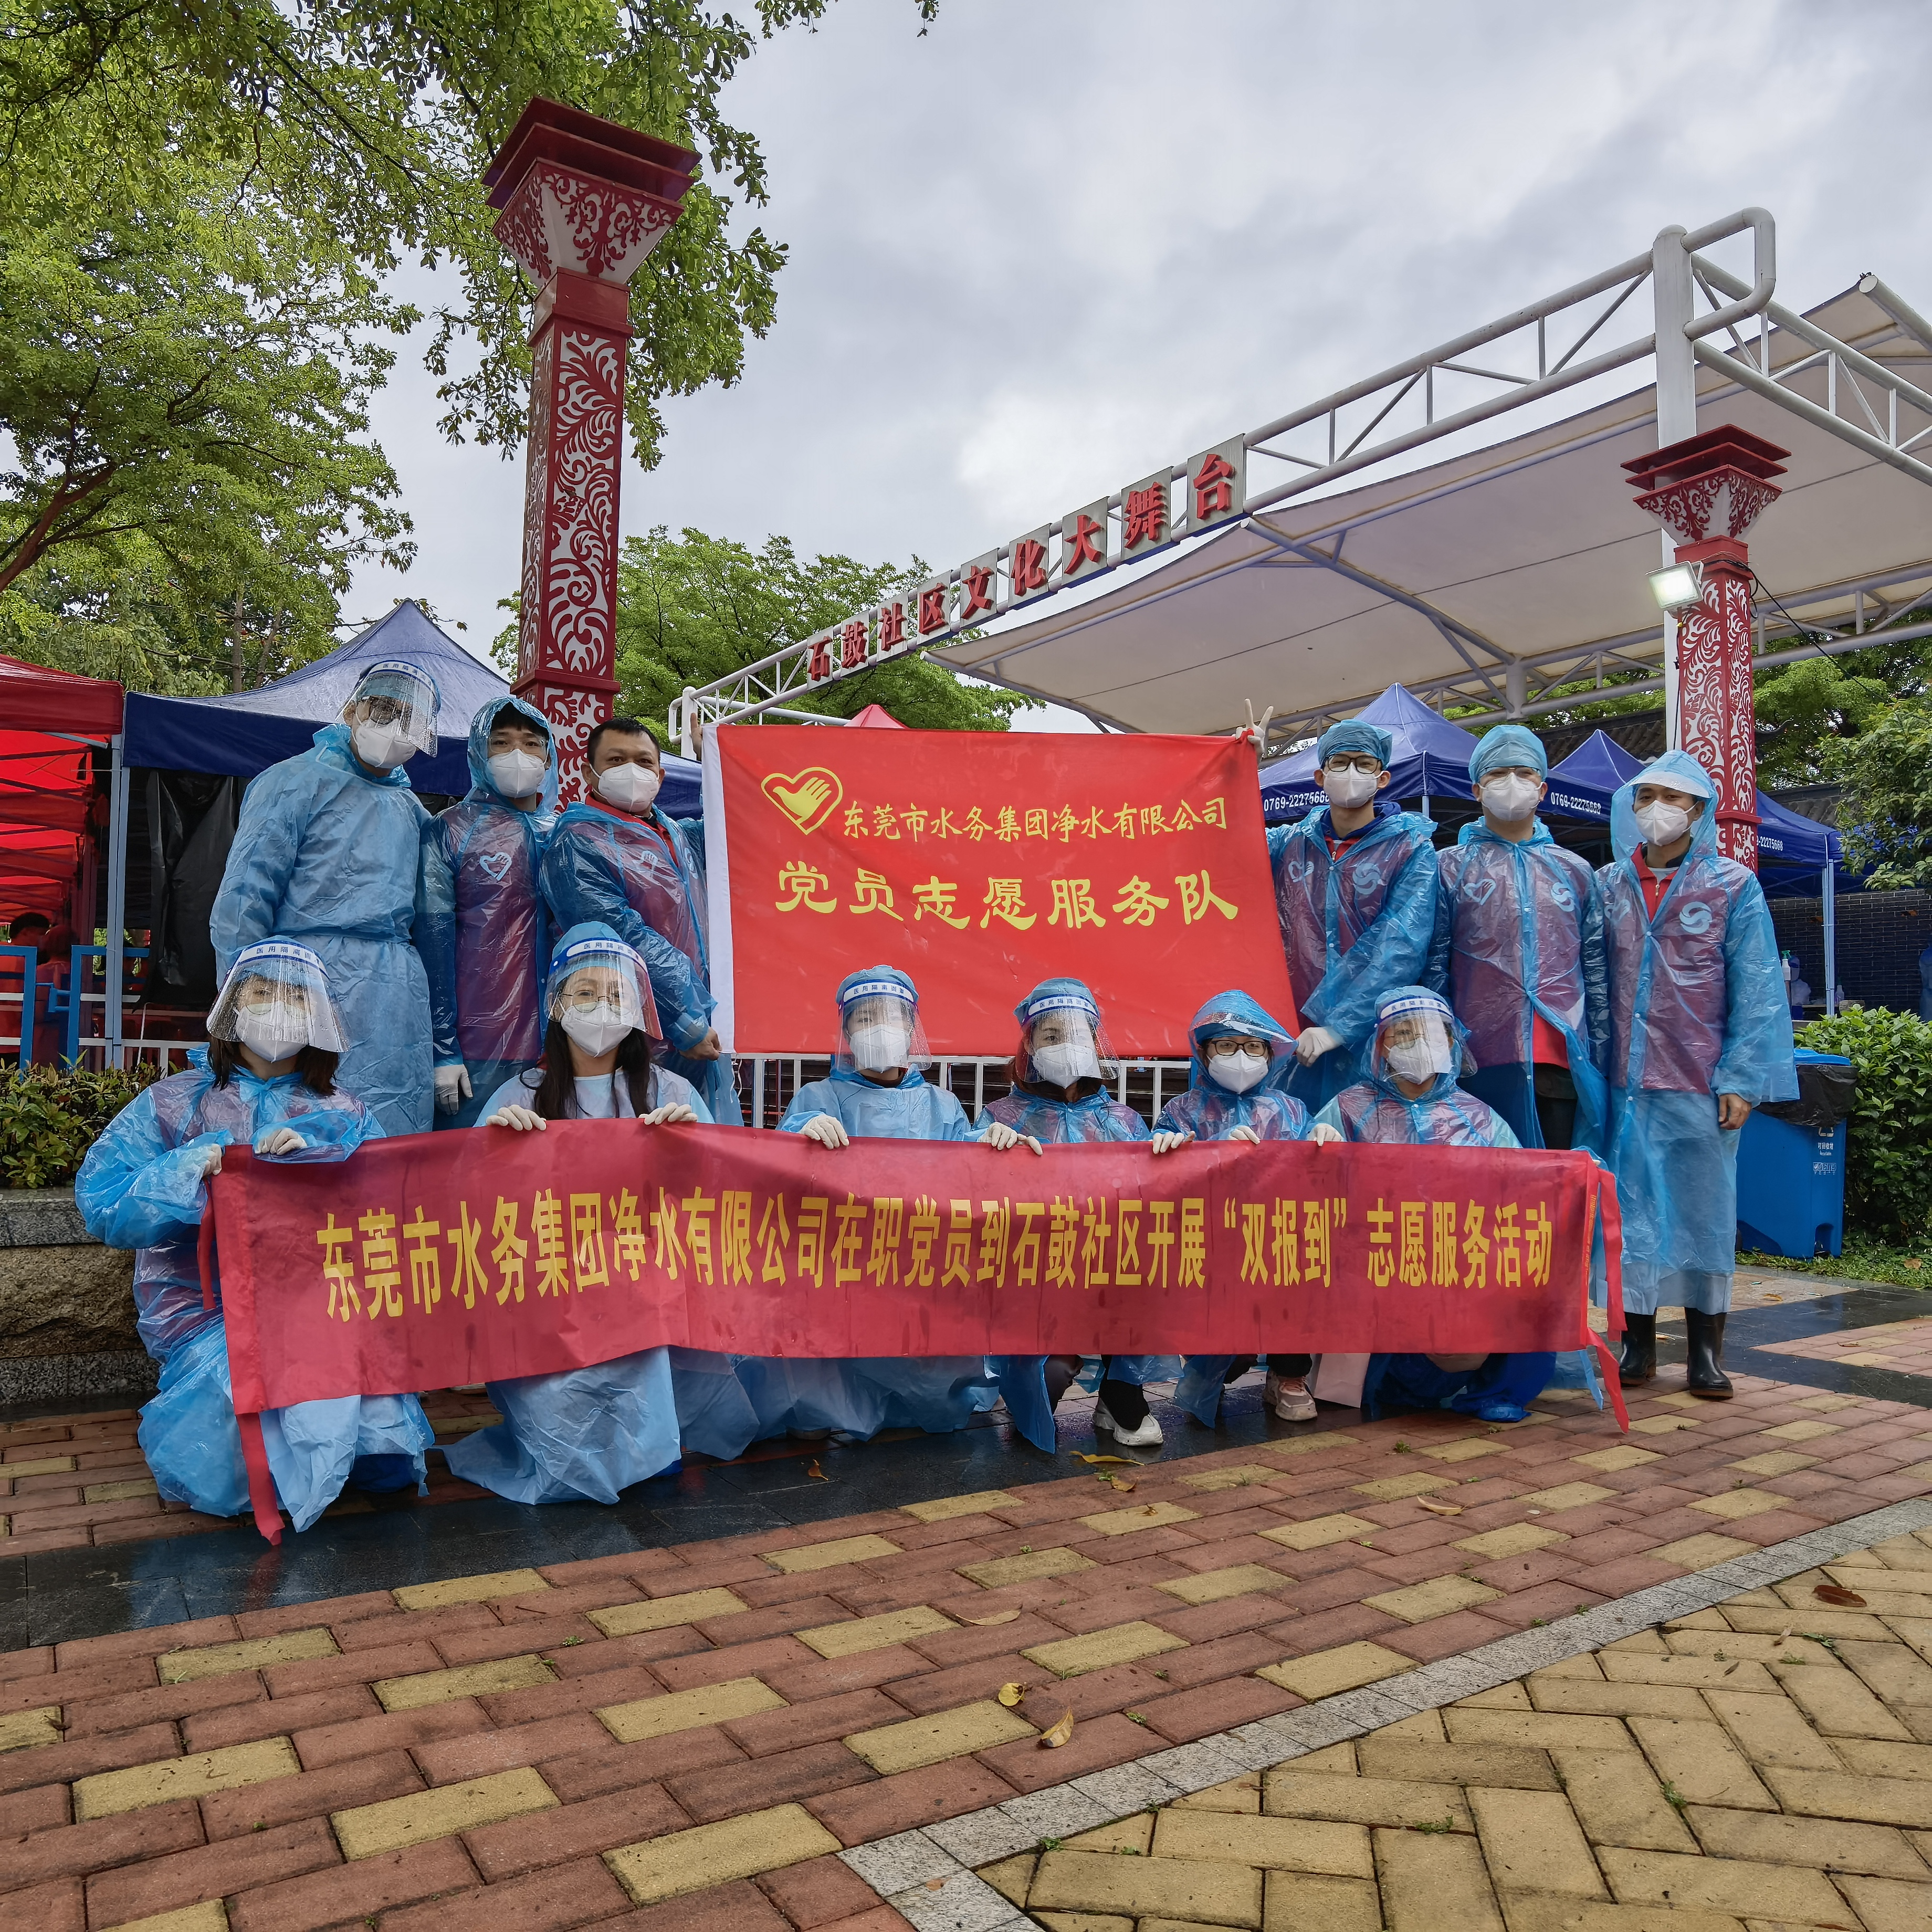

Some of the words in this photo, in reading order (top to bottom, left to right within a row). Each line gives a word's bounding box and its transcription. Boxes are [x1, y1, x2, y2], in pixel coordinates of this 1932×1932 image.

[807, 453, 1235, 681] 石鼓社区文化大舞台
[843, 796, 1226, 842] 东莞市水务集团净水有限公司
[1550, 792, 1601, 815] 0769-22275668
[775, 860, 1238, 930] 党员志愿服务队
